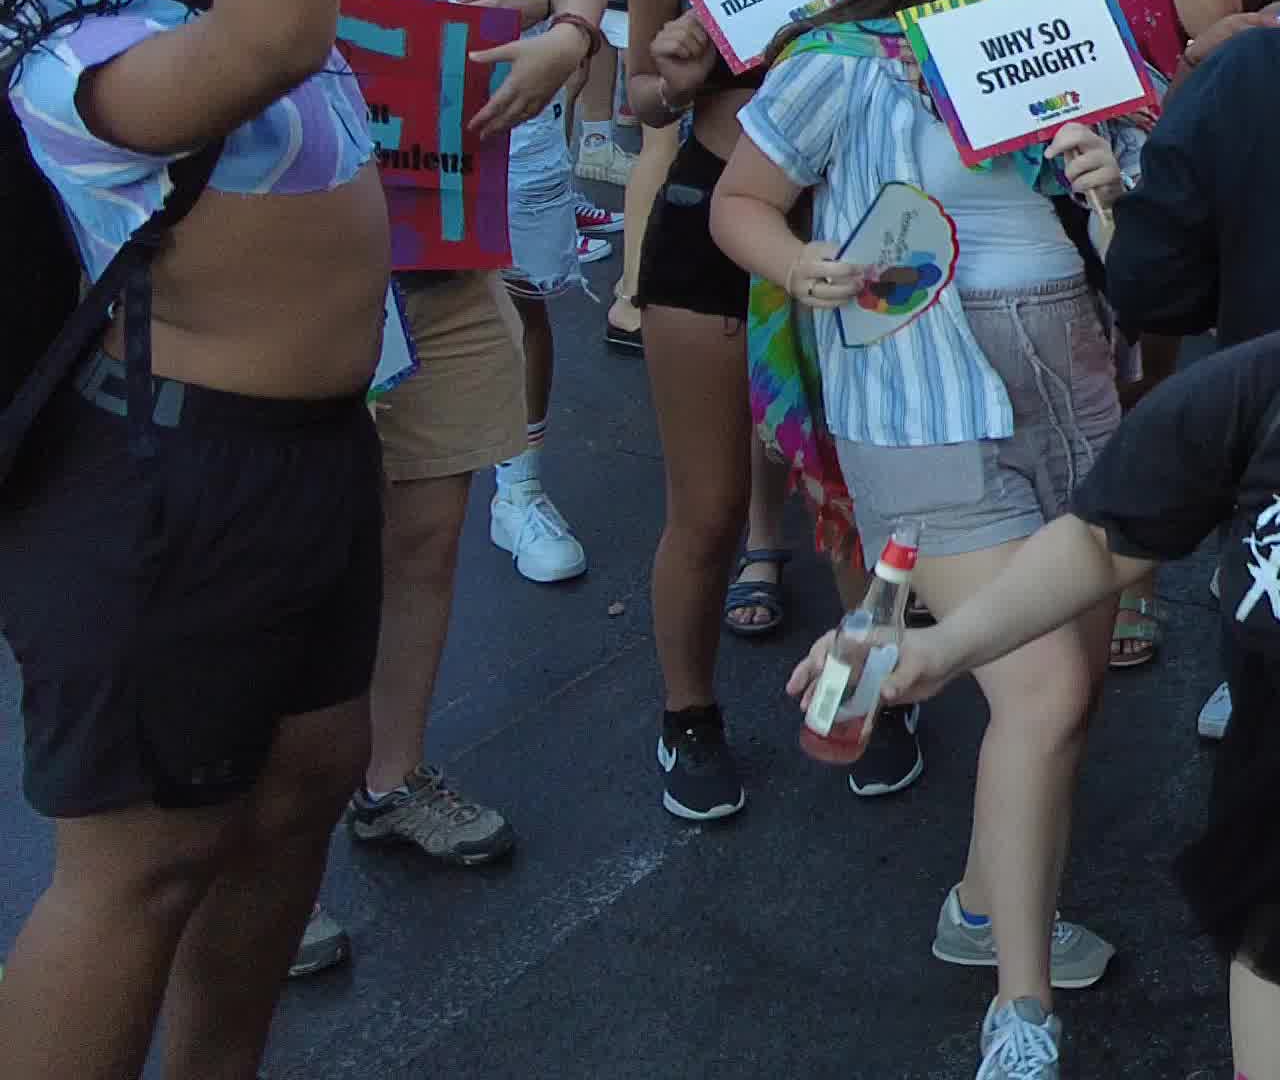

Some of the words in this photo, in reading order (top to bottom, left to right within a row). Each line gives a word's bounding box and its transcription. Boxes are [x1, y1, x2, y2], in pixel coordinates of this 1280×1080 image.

[981, 27, 1036, 62] WHY
[1037, 19, 1072, 45] SO
[976, 40, 1098, 95] STRAIGHT?
